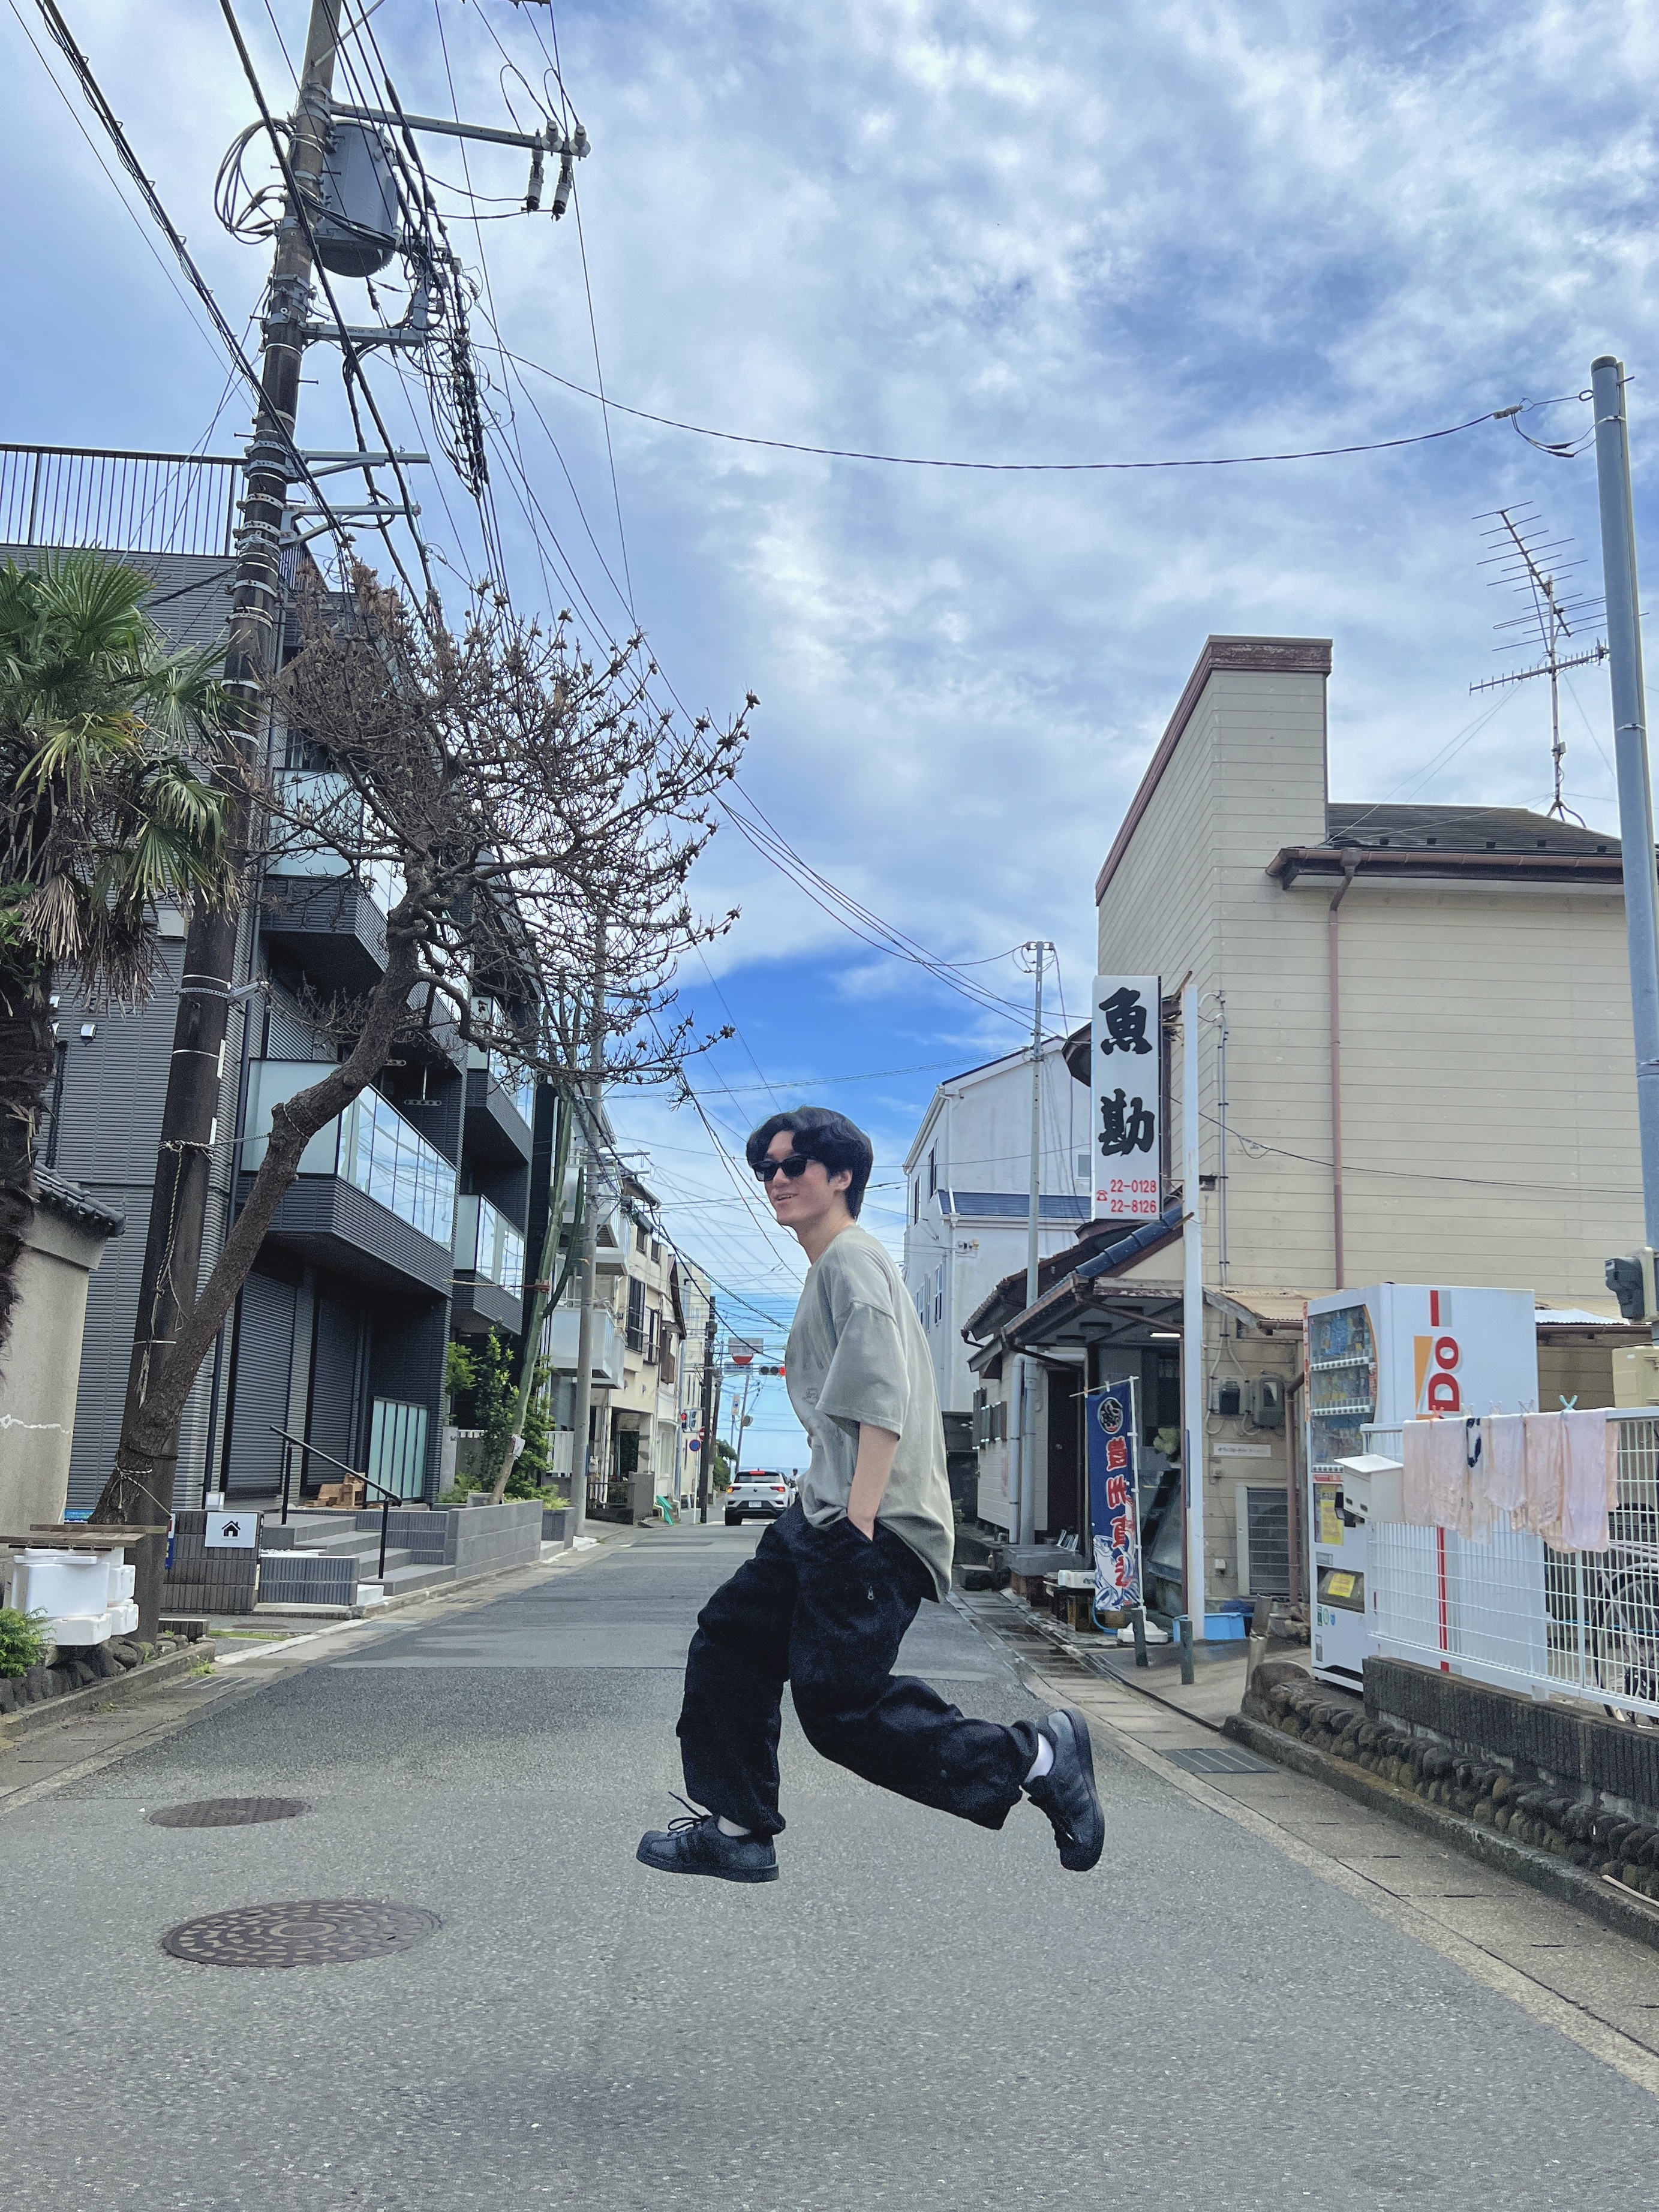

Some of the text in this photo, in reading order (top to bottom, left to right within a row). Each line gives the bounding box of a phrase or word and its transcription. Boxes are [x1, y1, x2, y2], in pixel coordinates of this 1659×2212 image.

[1098, 987, 1155, 1157] 魚勘
[1110, 1179, 1156, 1193] 22-0128
[1110, 1199, 1156, 1213] 22-8126
[1428, 1336, 1460, 1412] Do
